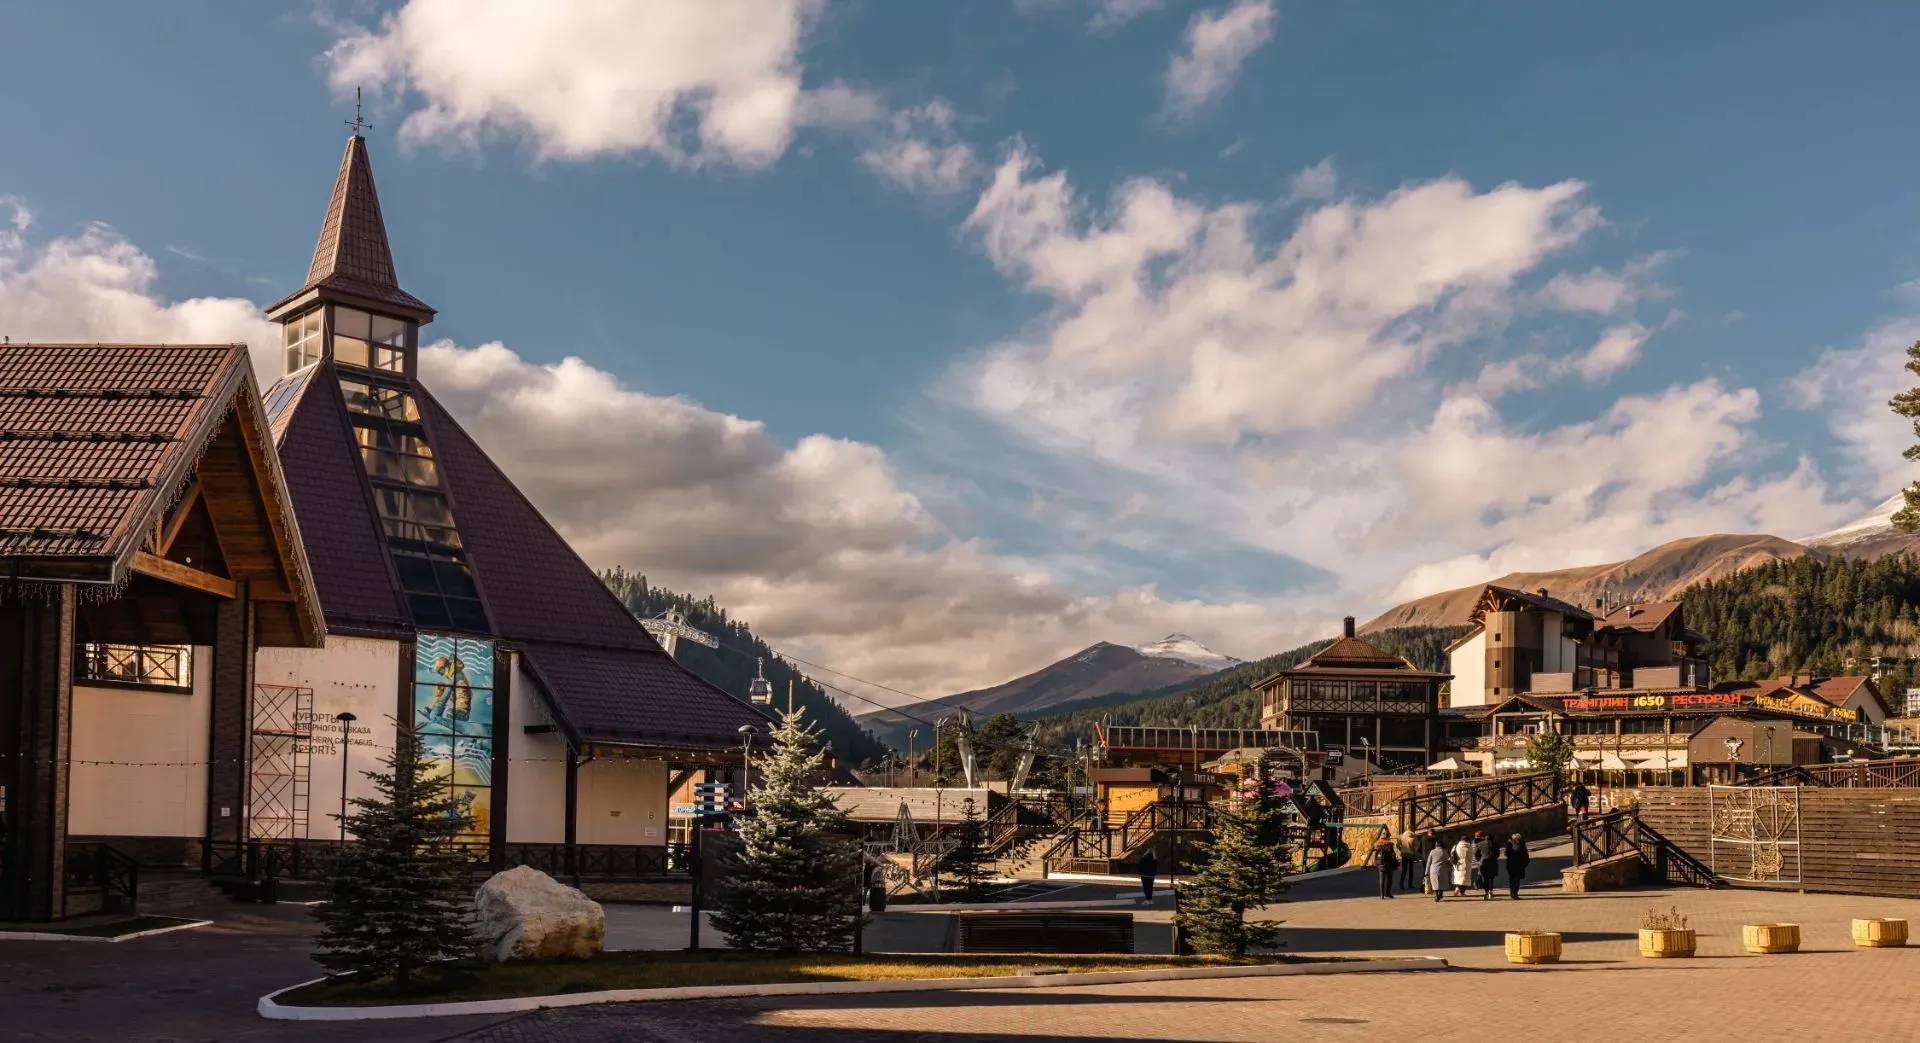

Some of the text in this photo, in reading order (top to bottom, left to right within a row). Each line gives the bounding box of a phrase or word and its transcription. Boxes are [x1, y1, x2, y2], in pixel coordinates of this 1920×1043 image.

[1562, 696, 1628, 707] ТРАМПЛИН
[1633, 695, 1665, 707] 1650
[1671, 693, 1742, 705] РЕСТОРАН
